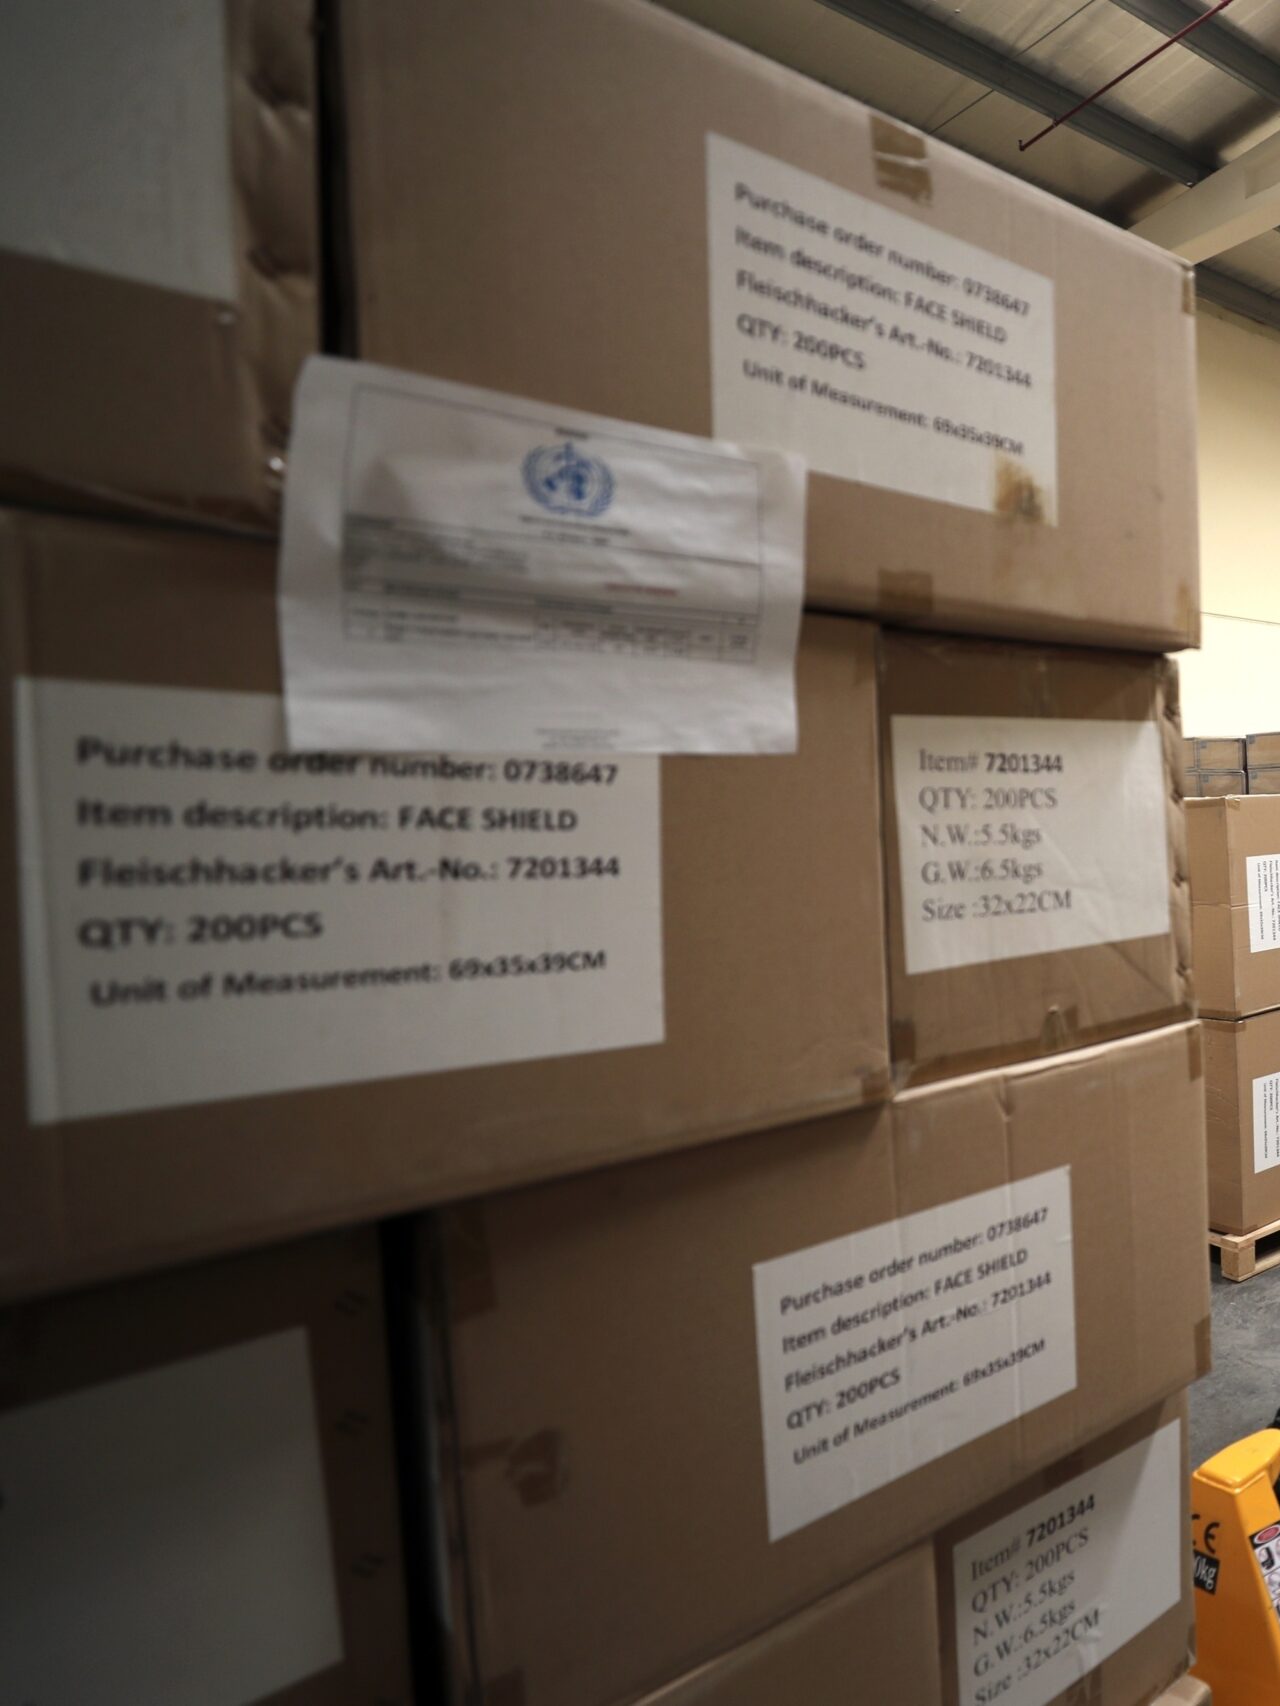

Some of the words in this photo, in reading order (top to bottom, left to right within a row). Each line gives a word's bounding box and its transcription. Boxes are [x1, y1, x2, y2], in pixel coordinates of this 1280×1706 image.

[734, 182, 830, 237] Purchase
[834, 227, 884, 258] order
[888, 249, 961, 288] number:
[963, 277, 1029, 318] 0738647
[735, 226, 786, 258] Item
[790, 248, 899, 304] description:
[904, 292, 946, 322] FACE
[952, 310, 1007, 343] SHIELD
[736, 314, 788, 347] QTY:
[793, 331, 866, 370] 200PCS
[742, 359, 783, 386] Unit
[788, 373, 807, 392] of
[811, 379, 928, 429] Measurement:
[966, 350, 1032, 388] 7201344
[77, 737, 256, 773] Purchase
[268, 752, 360, 776] order
[370, 756, 498, 782] number:
[503, 760, 619, 785] 0738647
[919, 748, 978, 772] Item#
[984, 752, 1064, 773] 7201344
[77, 799, 173, 828] Item
[183, 800, 389, 833] description:
[398, 809, 471, 831] FACE
[481, 809, 578, 832] SHIELD
[919, 786, 976, 812] QTY:
[983, 788, 1058, 810] 200PCS
[507, 857, 619, 880] 7201344
[78, 917, 176, 951] QTY:
[187, 913, 323, 943] 200PCS
[921, 898, 966, 922] Size
[90, 981, 166, 1008] Unit
[178, 974, 212, 999] of
[223, 962, 442, 997] Measurement:
[780, 1274, 864, 1314] Purchase
[869, 1257, 913, 1282] order
[918, 1232, 983, 1264] number:
[986, 1207, 1049, 1242] 0738647
[782, 1328, 826, 1354] Item
[831, 1288, 930, 1336] description:
[934, 1271, 973, 1295] FACE
[977, 1248, 1028, 1279] SHIELD
[991, 1271, 1052, 1308] 7201344
[786, 1400, 831, 1430] QTY:
[836, 1368, 902, 1410] 200PCS
[793, 1439, 829, 1465] Unit
[833, 1424, 850, 1447] of
[853, 1380, 959, 1438] Measurement:
[971, 1537, 1022, 1581] Item#
[1026, 1494, 1095, 1547] 7201344
[971, 1573, 1019, 1614] QTY:
[1025, 1528, 1089, 1581] 200PCS
